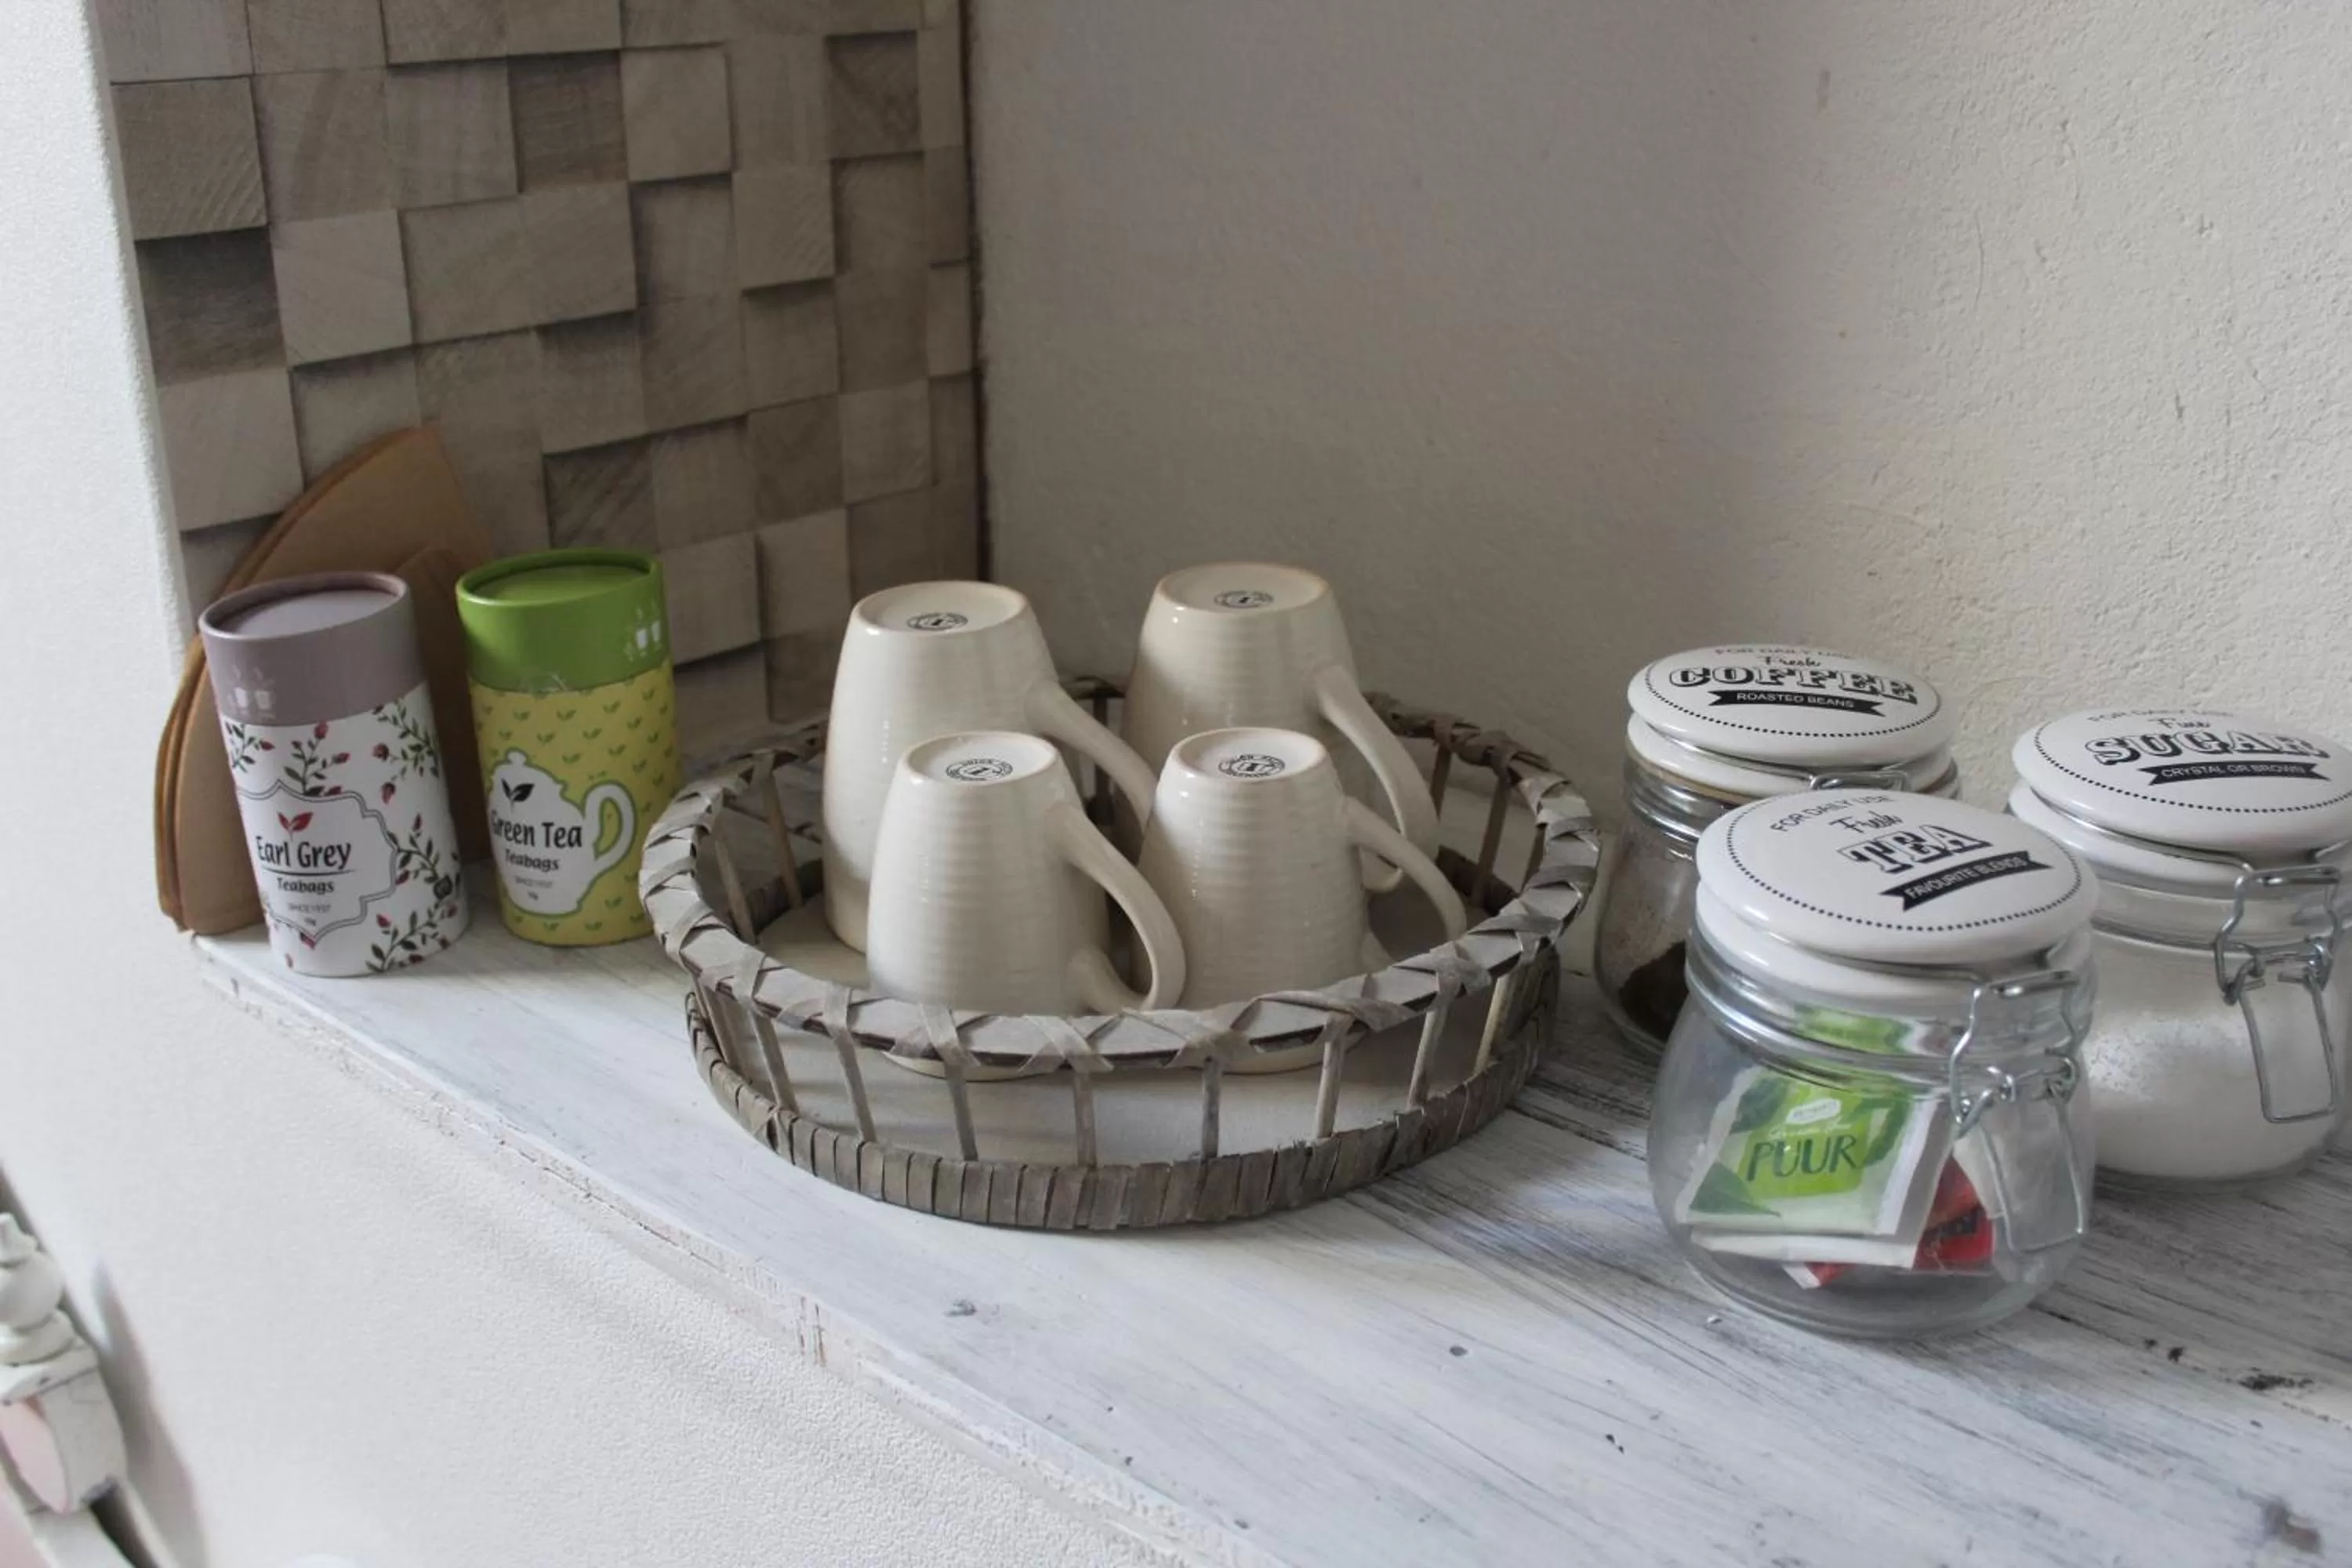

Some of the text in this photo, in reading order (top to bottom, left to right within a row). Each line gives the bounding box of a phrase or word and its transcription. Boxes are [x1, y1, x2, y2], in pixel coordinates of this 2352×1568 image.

[1669, 666, 1918, 706] COFFEE
[1737, 692, 1854, 708] ROASTED BEANS
[2085, 729, 2330, 766] SUGAR
[2161, 764, 2225, 778] CRYSTAL
[490, 809, 583, 849] Green Tea
[1769, 812, 1805, 832] FOR
[256, 835, 352, 870] Earl Grey
[505, 848, 560, 873] Teabags
[1837, 824, 1994, 874] TEA
[277, 877, 335, 895] Teabags
[1746, 1134, 1857, 1181] PUUR
